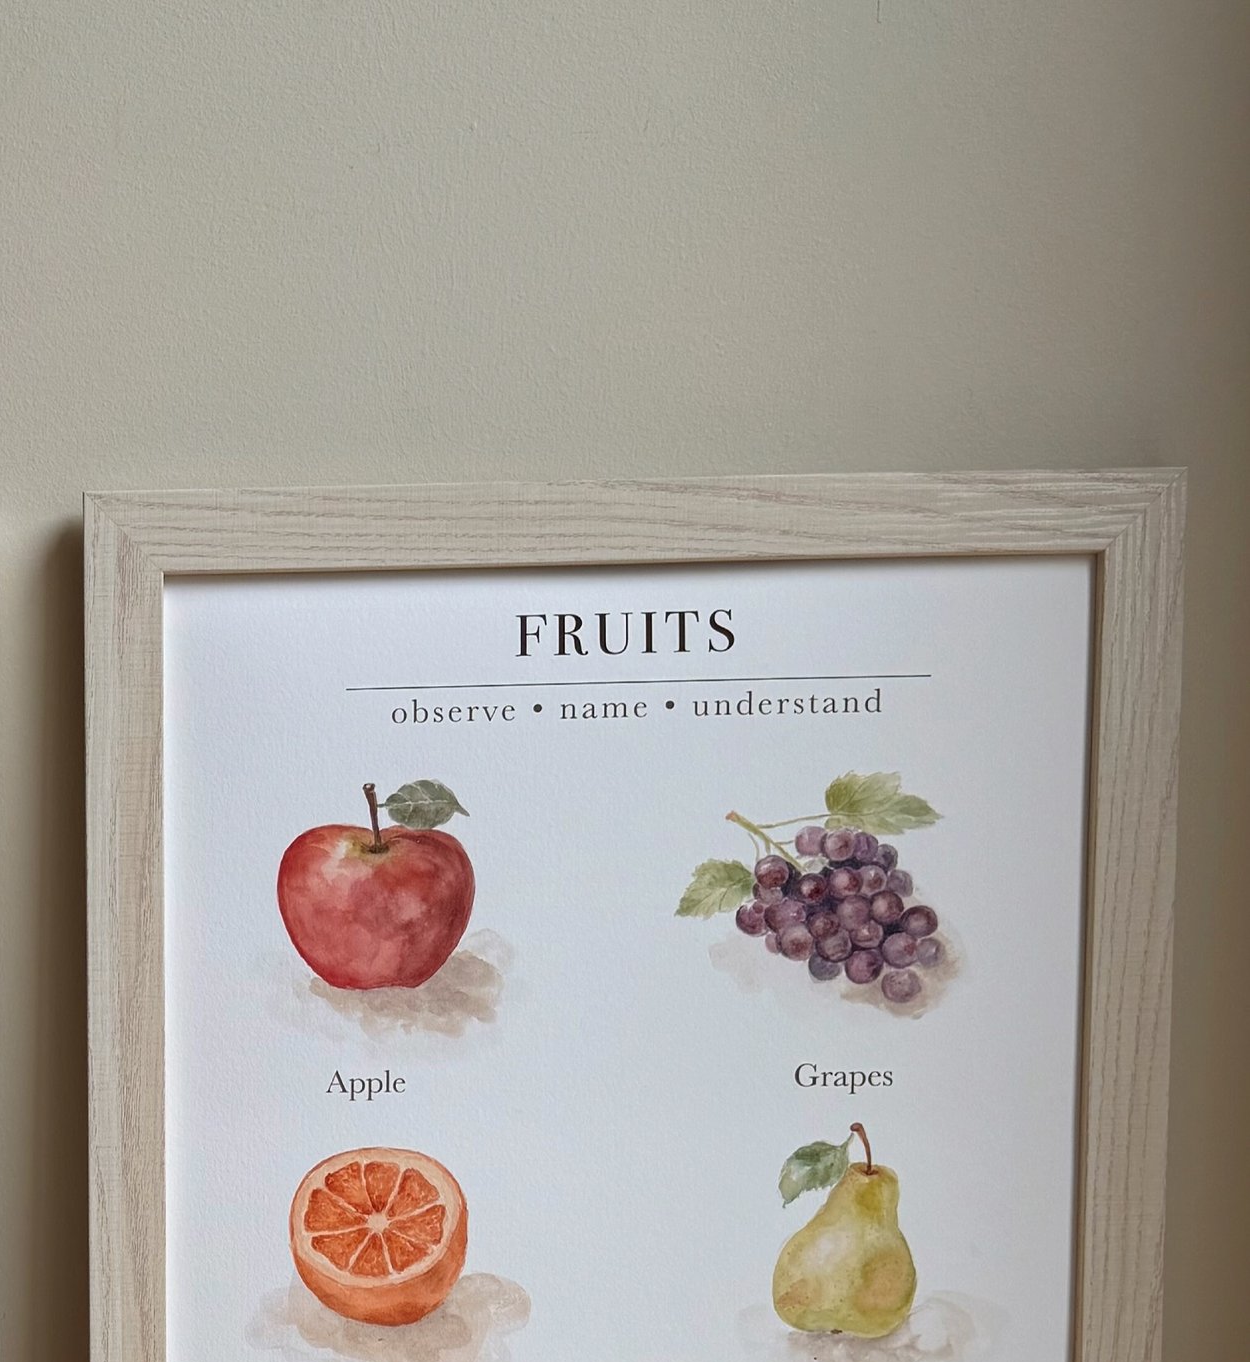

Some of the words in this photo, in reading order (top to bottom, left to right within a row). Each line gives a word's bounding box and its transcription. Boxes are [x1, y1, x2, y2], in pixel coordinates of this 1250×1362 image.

[516, 609, 736, 659] FRUITS
[391, 698, 518, 725] observe
[560, 699, 651, 722] name
[692, 688, 884, 718] understand
[326, 1070, 407, 1103] Apple
[795, 1063, 895, 1096] Grapes
